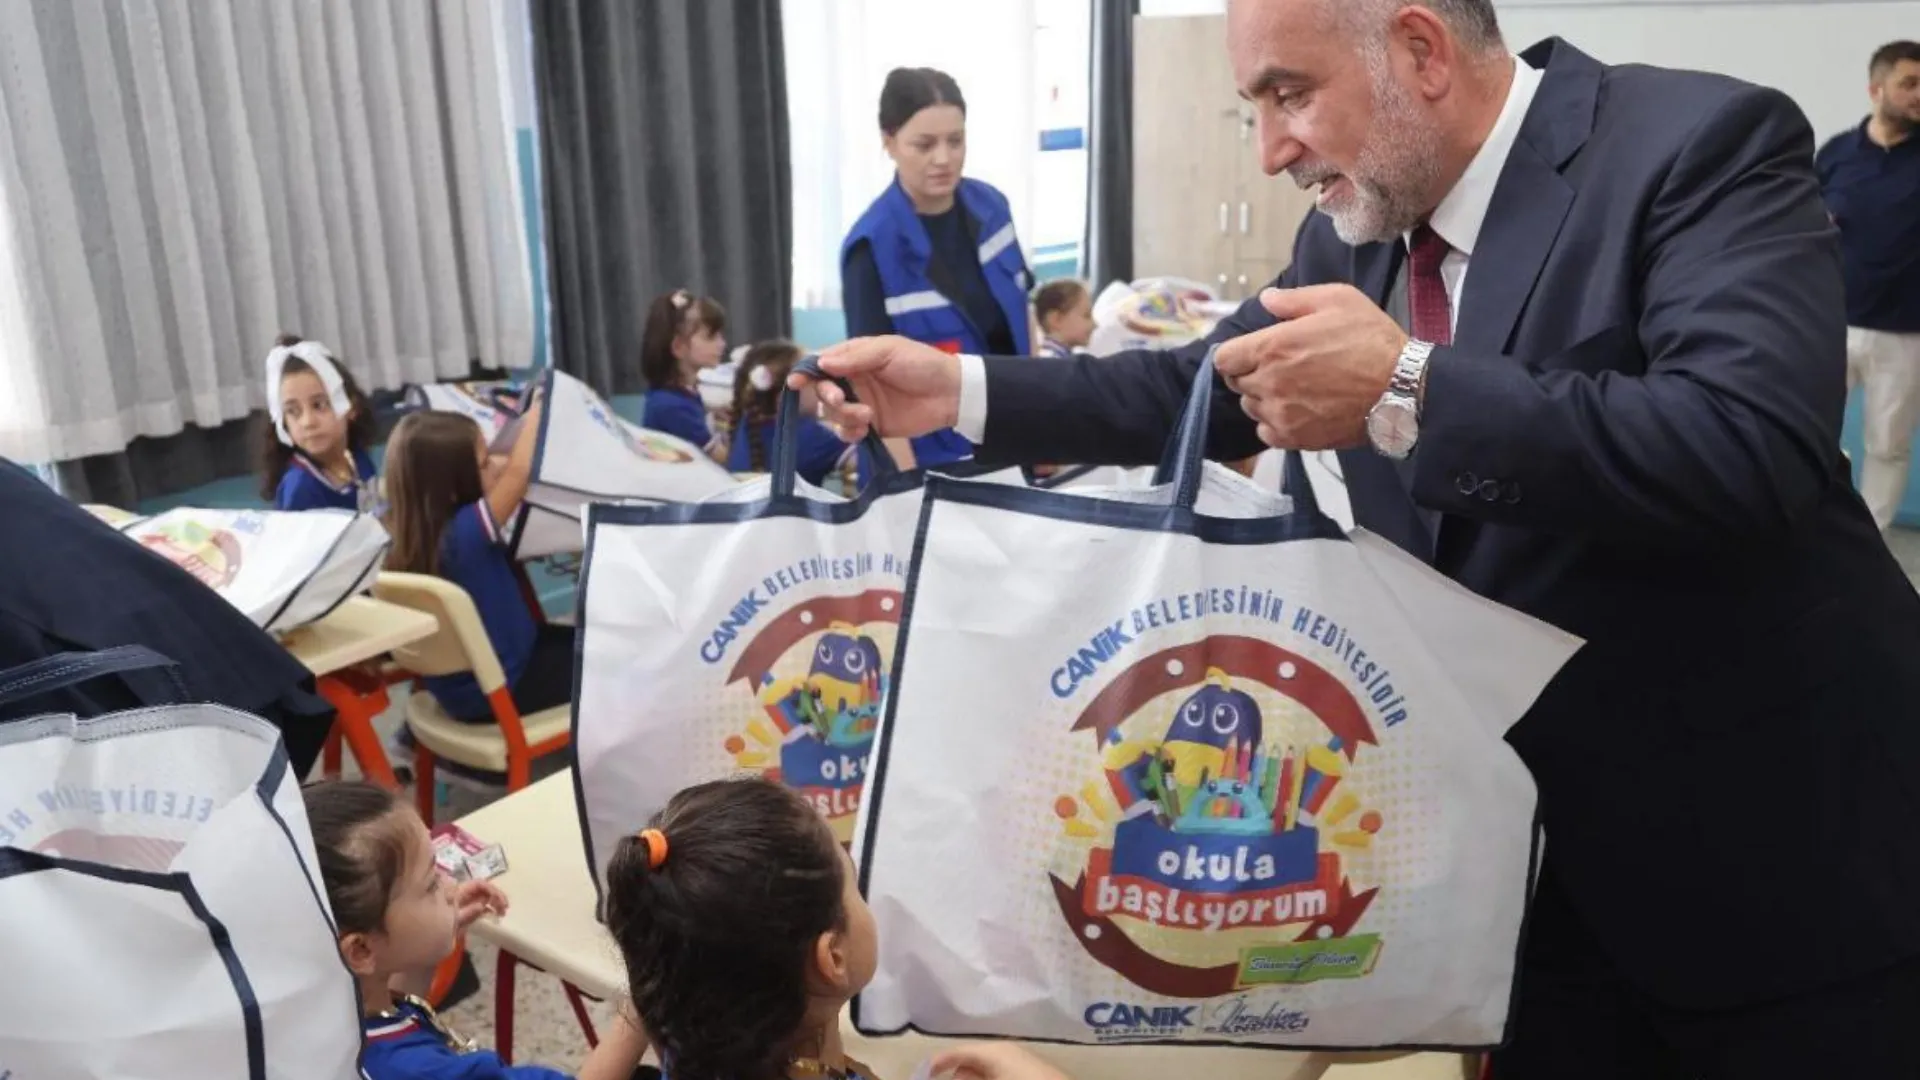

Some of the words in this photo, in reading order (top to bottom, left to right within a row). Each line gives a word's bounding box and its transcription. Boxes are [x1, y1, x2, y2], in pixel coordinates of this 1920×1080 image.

[1292, 606, 1408, 729] HEDİYESİDİR
[1158, 845, 1275, 882] okula
[1096, 875, 1327, 935] başlıyorum
